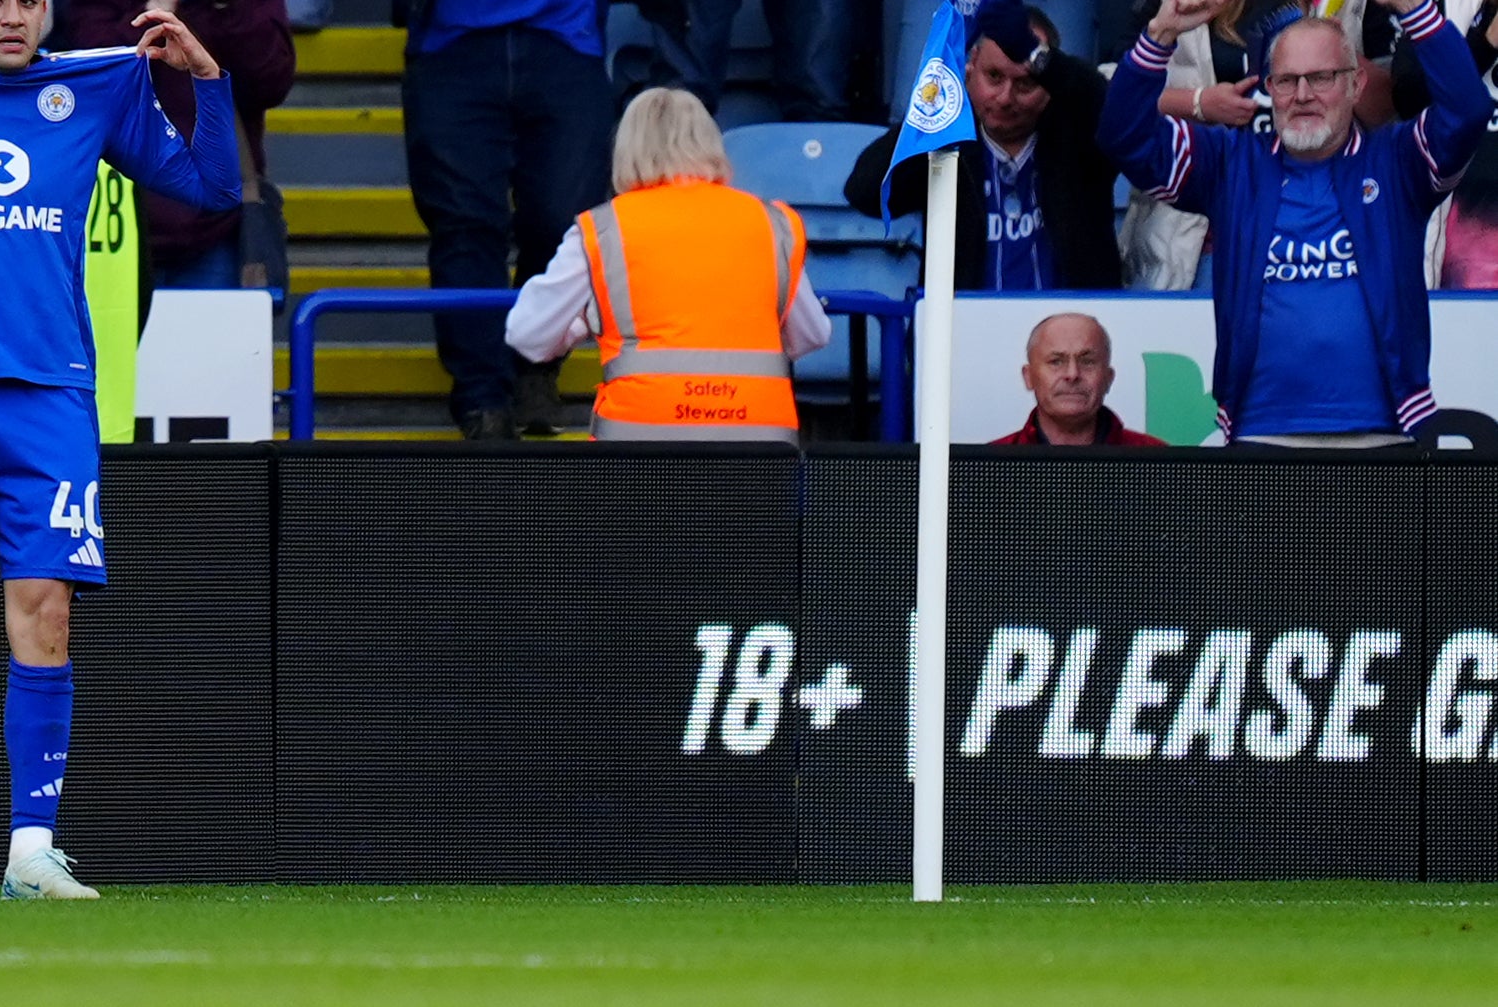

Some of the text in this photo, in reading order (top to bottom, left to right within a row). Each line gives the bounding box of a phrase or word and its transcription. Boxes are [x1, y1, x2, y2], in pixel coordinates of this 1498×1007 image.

[1263, 259, 1359, 284] POWER
[684, 380, 738, 401] Safety
[674, 403, 748, 421] Steward
[681, 621, 1498, 762] 18+ PLEASE G
